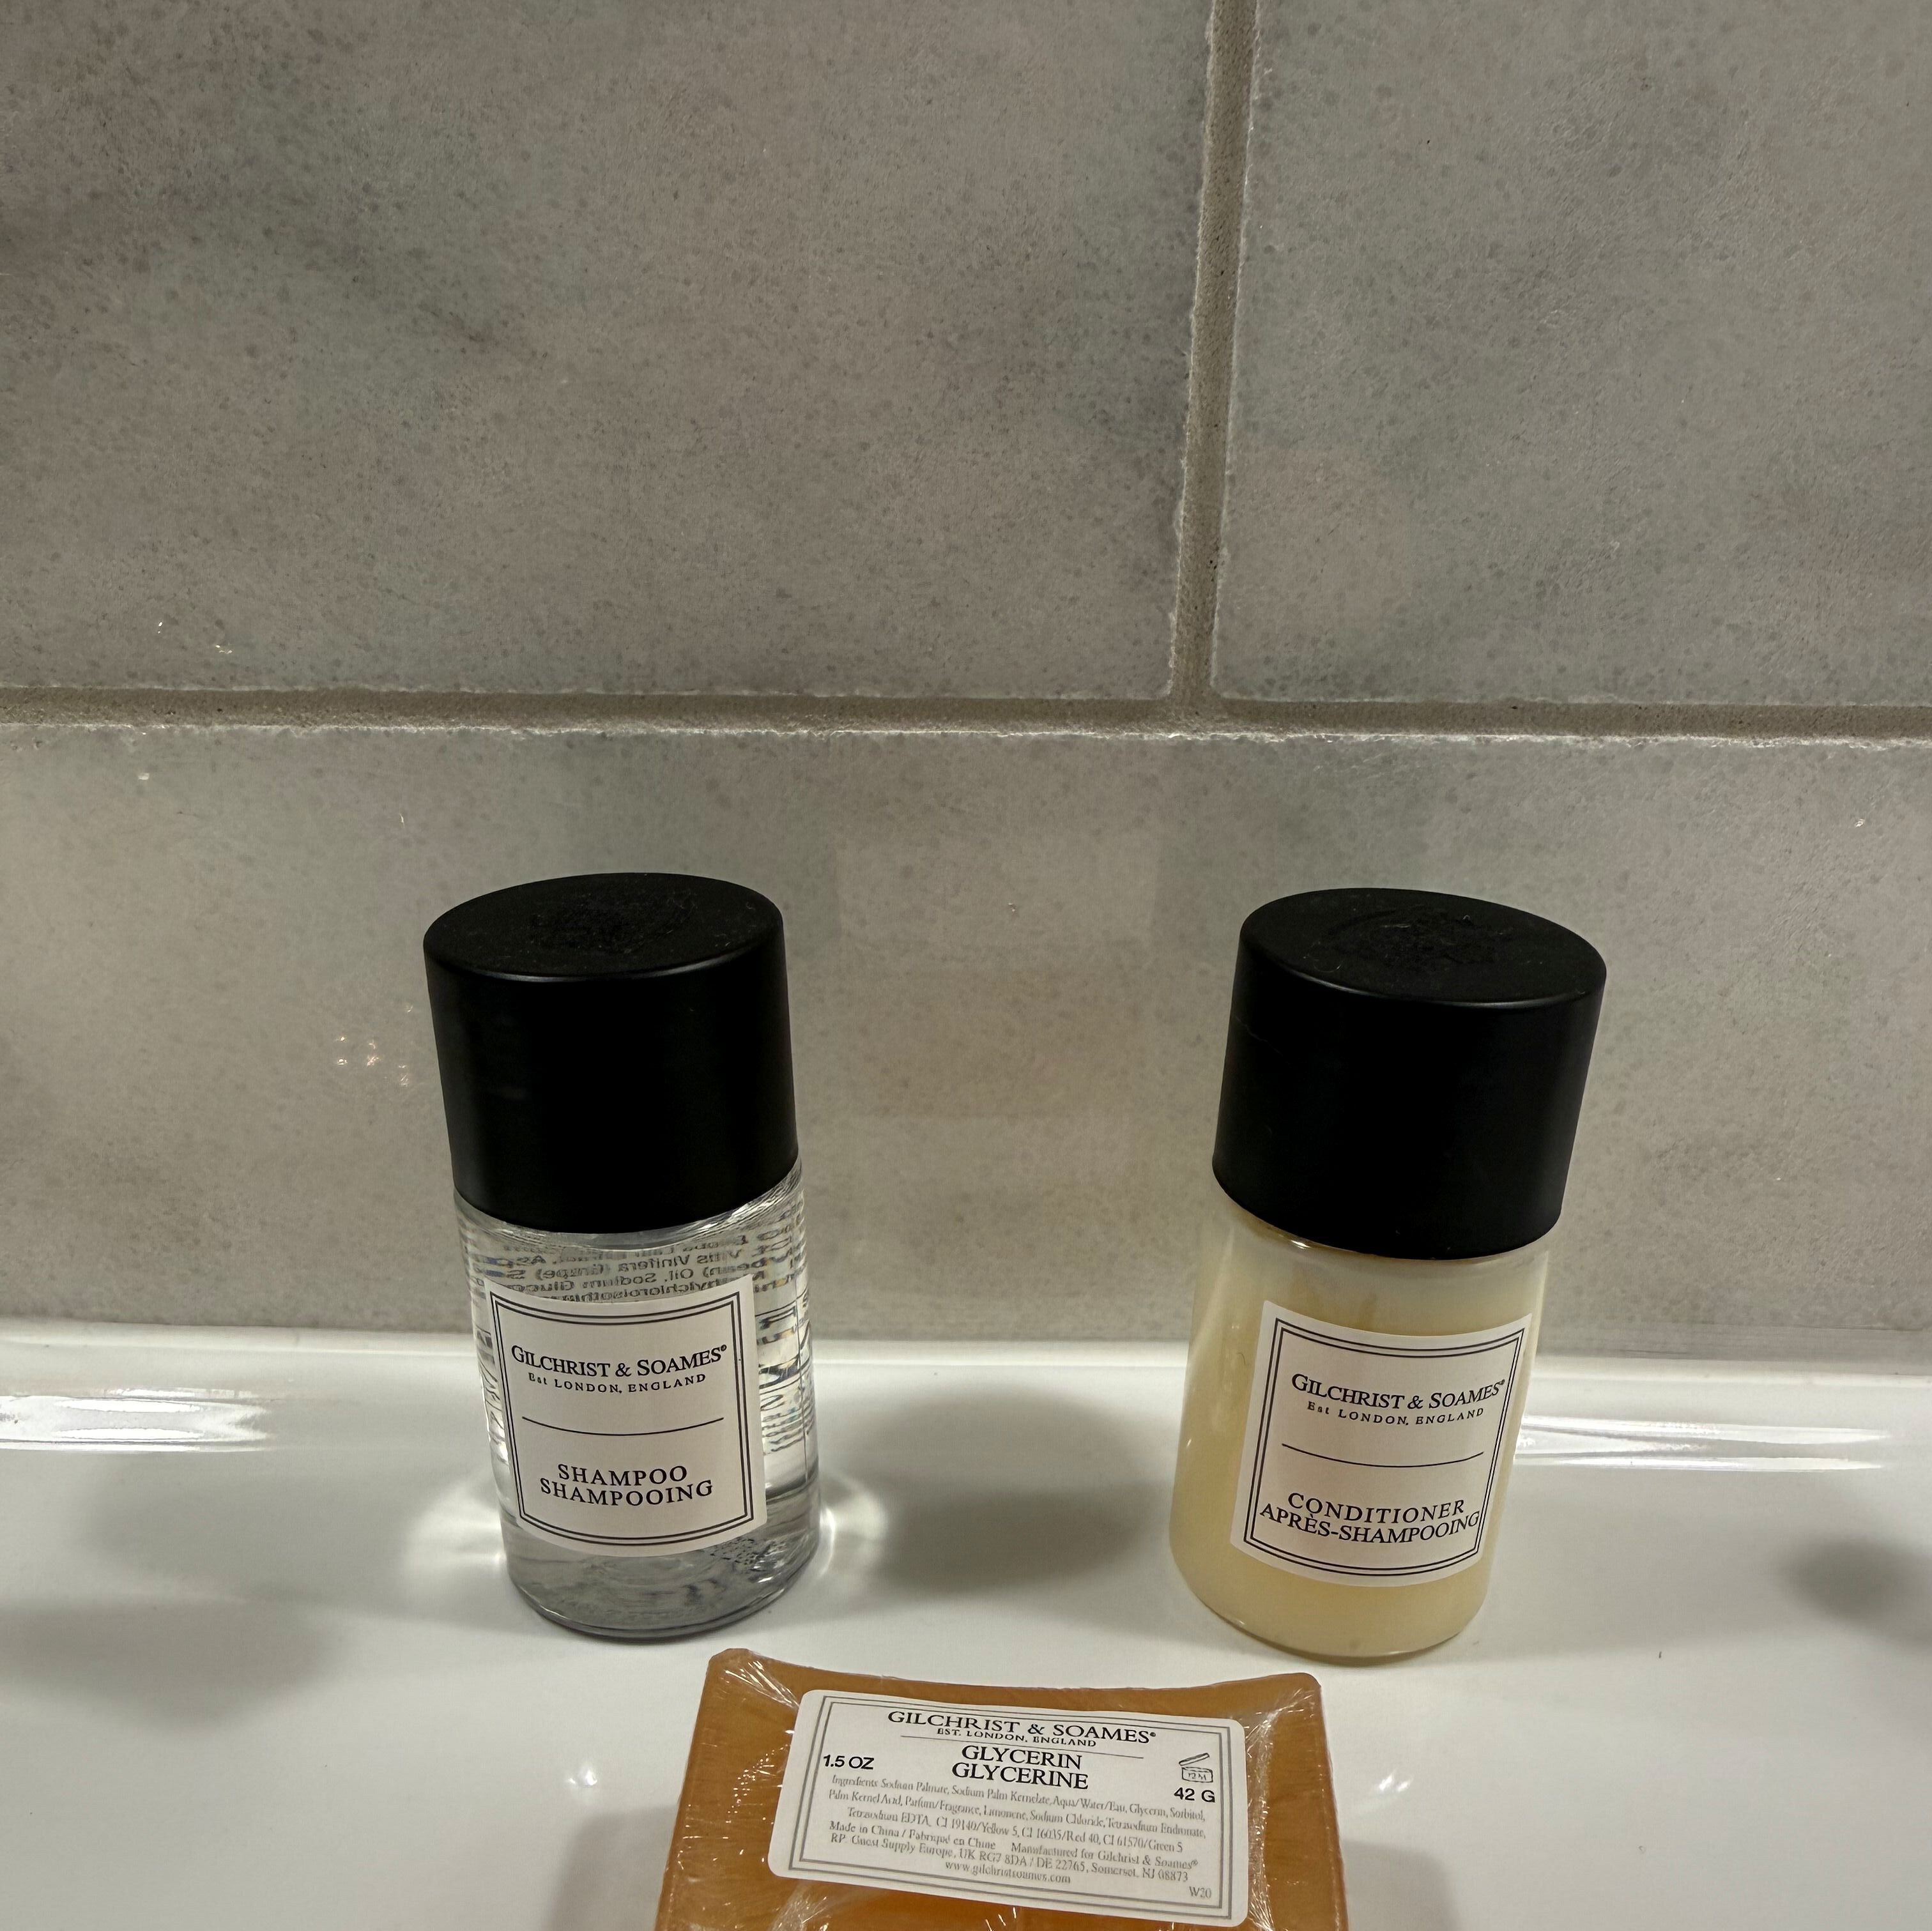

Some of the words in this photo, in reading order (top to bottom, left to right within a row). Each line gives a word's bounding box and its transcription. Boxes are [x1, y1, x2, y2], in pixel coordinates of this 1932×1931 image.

[511, 1344, 610, 1377] GILCHRIST
[615, 1362, 631, 1377] &
[628, 1373, 706, 1393] ENGLAND
[1291, 1373, 1405, 1409] GILCHRIST
[1407, 1396, 1424, 1409] &
[1416, 1407, 1484, 1425] ENGLAND
[558, 1463, 687, 1486] SHAMPOO
[540, 1477, 713, 1506] SHAMPOOING
[1288, 1492, 1465, 1524] CONDITIONER
[1260, 1502, 1480, 1544] APRÈS-SHAMPOOING
[887, 1711, 1020, 1733] GILCHRIST
[1027, 1723, 1045, 1735] &
[937, 1728, 962, 1736] EST.
[1033, 1736, 1096, 1747] ENGLAND
[824, 1754, 845, 1767] 1.5
[848, 1756, 875, 1769] OZ
[962, 1745, 1082, 1770] GLYCERIN
[952, 1762, 1089, 1790] GLYCERINE
[951, 1785, 985, 1797] Sodium
[987, 1788, 1008, 1800] Palm
[1130, 1804, 1168, 1818] Glycerin,
[1170, 1807, 1206, 1822] Sorbitol,
[1174, 1787, 1195, 1801] 42
[1201, 1789, 1216, 1803] G
[829, 1789, 849, 1800] Palm
[852, 1791, 880, 1803] Kernel
[881, 1794, 903, 1806] Acid,
[905, 1796, 981, 1816] Parfum/Fragrance,
[984, 1805, 1028, 1820] Limonene,
[1030, 1810, 1063, 1823] Sodium
[1066, 1813, 1106, 1828] Chloride,
[1107, 1817, 1158, 1833] Tetrasodium
[829, 1820, 855, 1833] Made
[859, 1825, 868, 1833] in
[871, 1825, 900, 1837] China
[901, 1829, 907, 1838] /
[968, 1837, 996, 1850] Chine
[1011, 1842, 1078, 1858] Manufactured
[1081, 1848, 1094, 1859] for
[1098, 1851, 1139, 1865] Gilchrist
[1142, 1855, 1151, 1865] &
[847, 1806, 898, 1822] Tetrasodium
[937, 1817, 947, 1828] CI
[952, 1819, 1009, 1835] 19140/Yellow
[1012, 1826, 1020, 1838] 5,
[1022, 1828, 1032, 1838] CI
[1037, 1828, 1085, 1842] 16035/Red
[1089, 1833, 1101, 1845] 40,
[1103, 1834, 1114, 1845] CI
[1117, 1836, 1175, 1852] 61570/Green
[852, 1835, 878, 1847] Guest
[881, 1838, 916, 1854] Supply
[919, 1843, 956, 1859] Europe,
[959, 1848, 976, 1860] UK
[979, 1851, 1002, 1863] RG7
[1004, 1854, 1027, 1866] 8DA
[1029, 1857, 1034, 1867] /
[1037, 1858, 1053, 1869] DE
[1055, 1859, 1089, 1874] 22765,
[1142, 1867, 1154, 1879] NJ
[1158, 1870, 1188, 1882] 08873
[946, 1861, 1071, 1884] www.gilchristsoames.com
